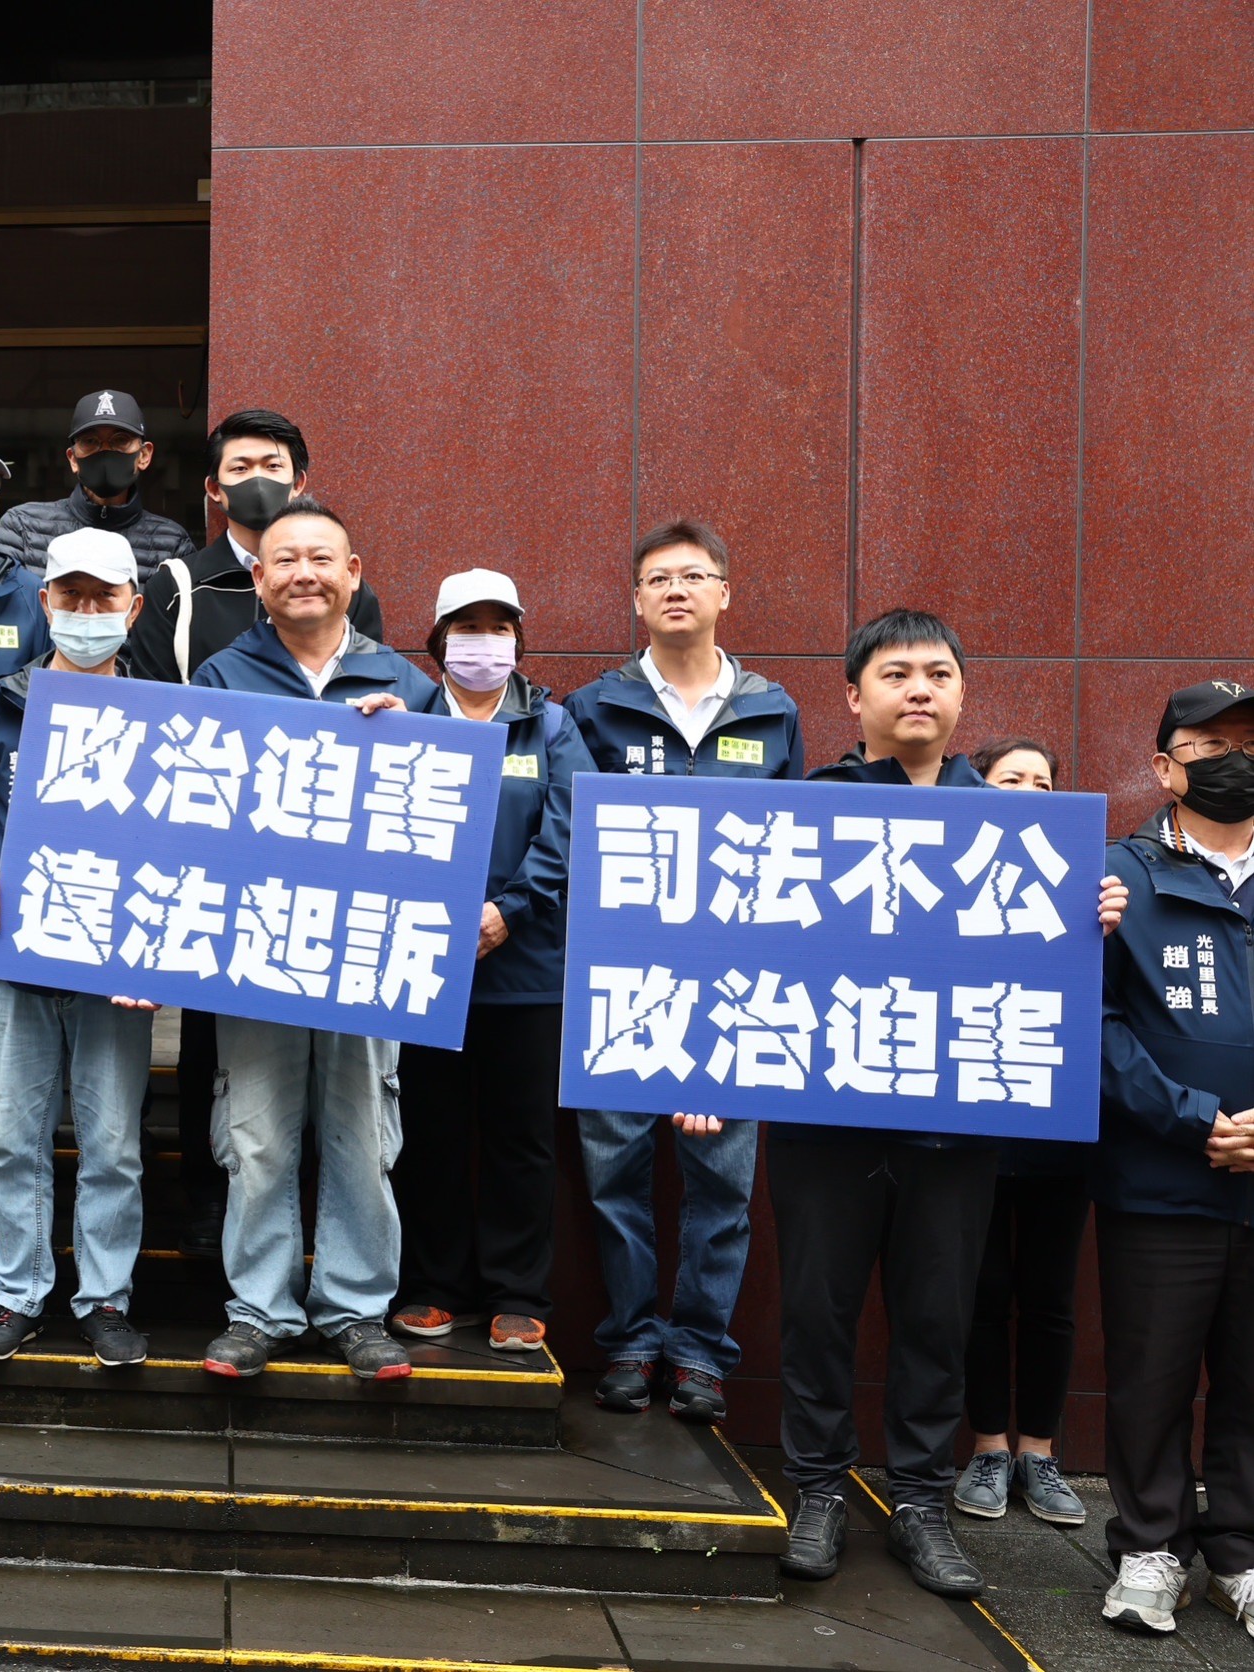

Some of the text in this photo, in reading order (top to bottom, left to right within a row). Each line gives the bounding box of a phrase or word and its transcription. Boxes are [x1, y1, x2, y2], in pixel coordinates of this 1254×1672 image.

[37, 704, 472, 861] 政治迫害
[13, 845, 451, 1014] 違法起訴
[596, 803, 1070, 942] 司法不公
[583, 964, 1064, 1108] 政治迫害
[1162, 945, 1193, 1010] 趙強
[1196, 934, 1218, 1015] 光明里里長
